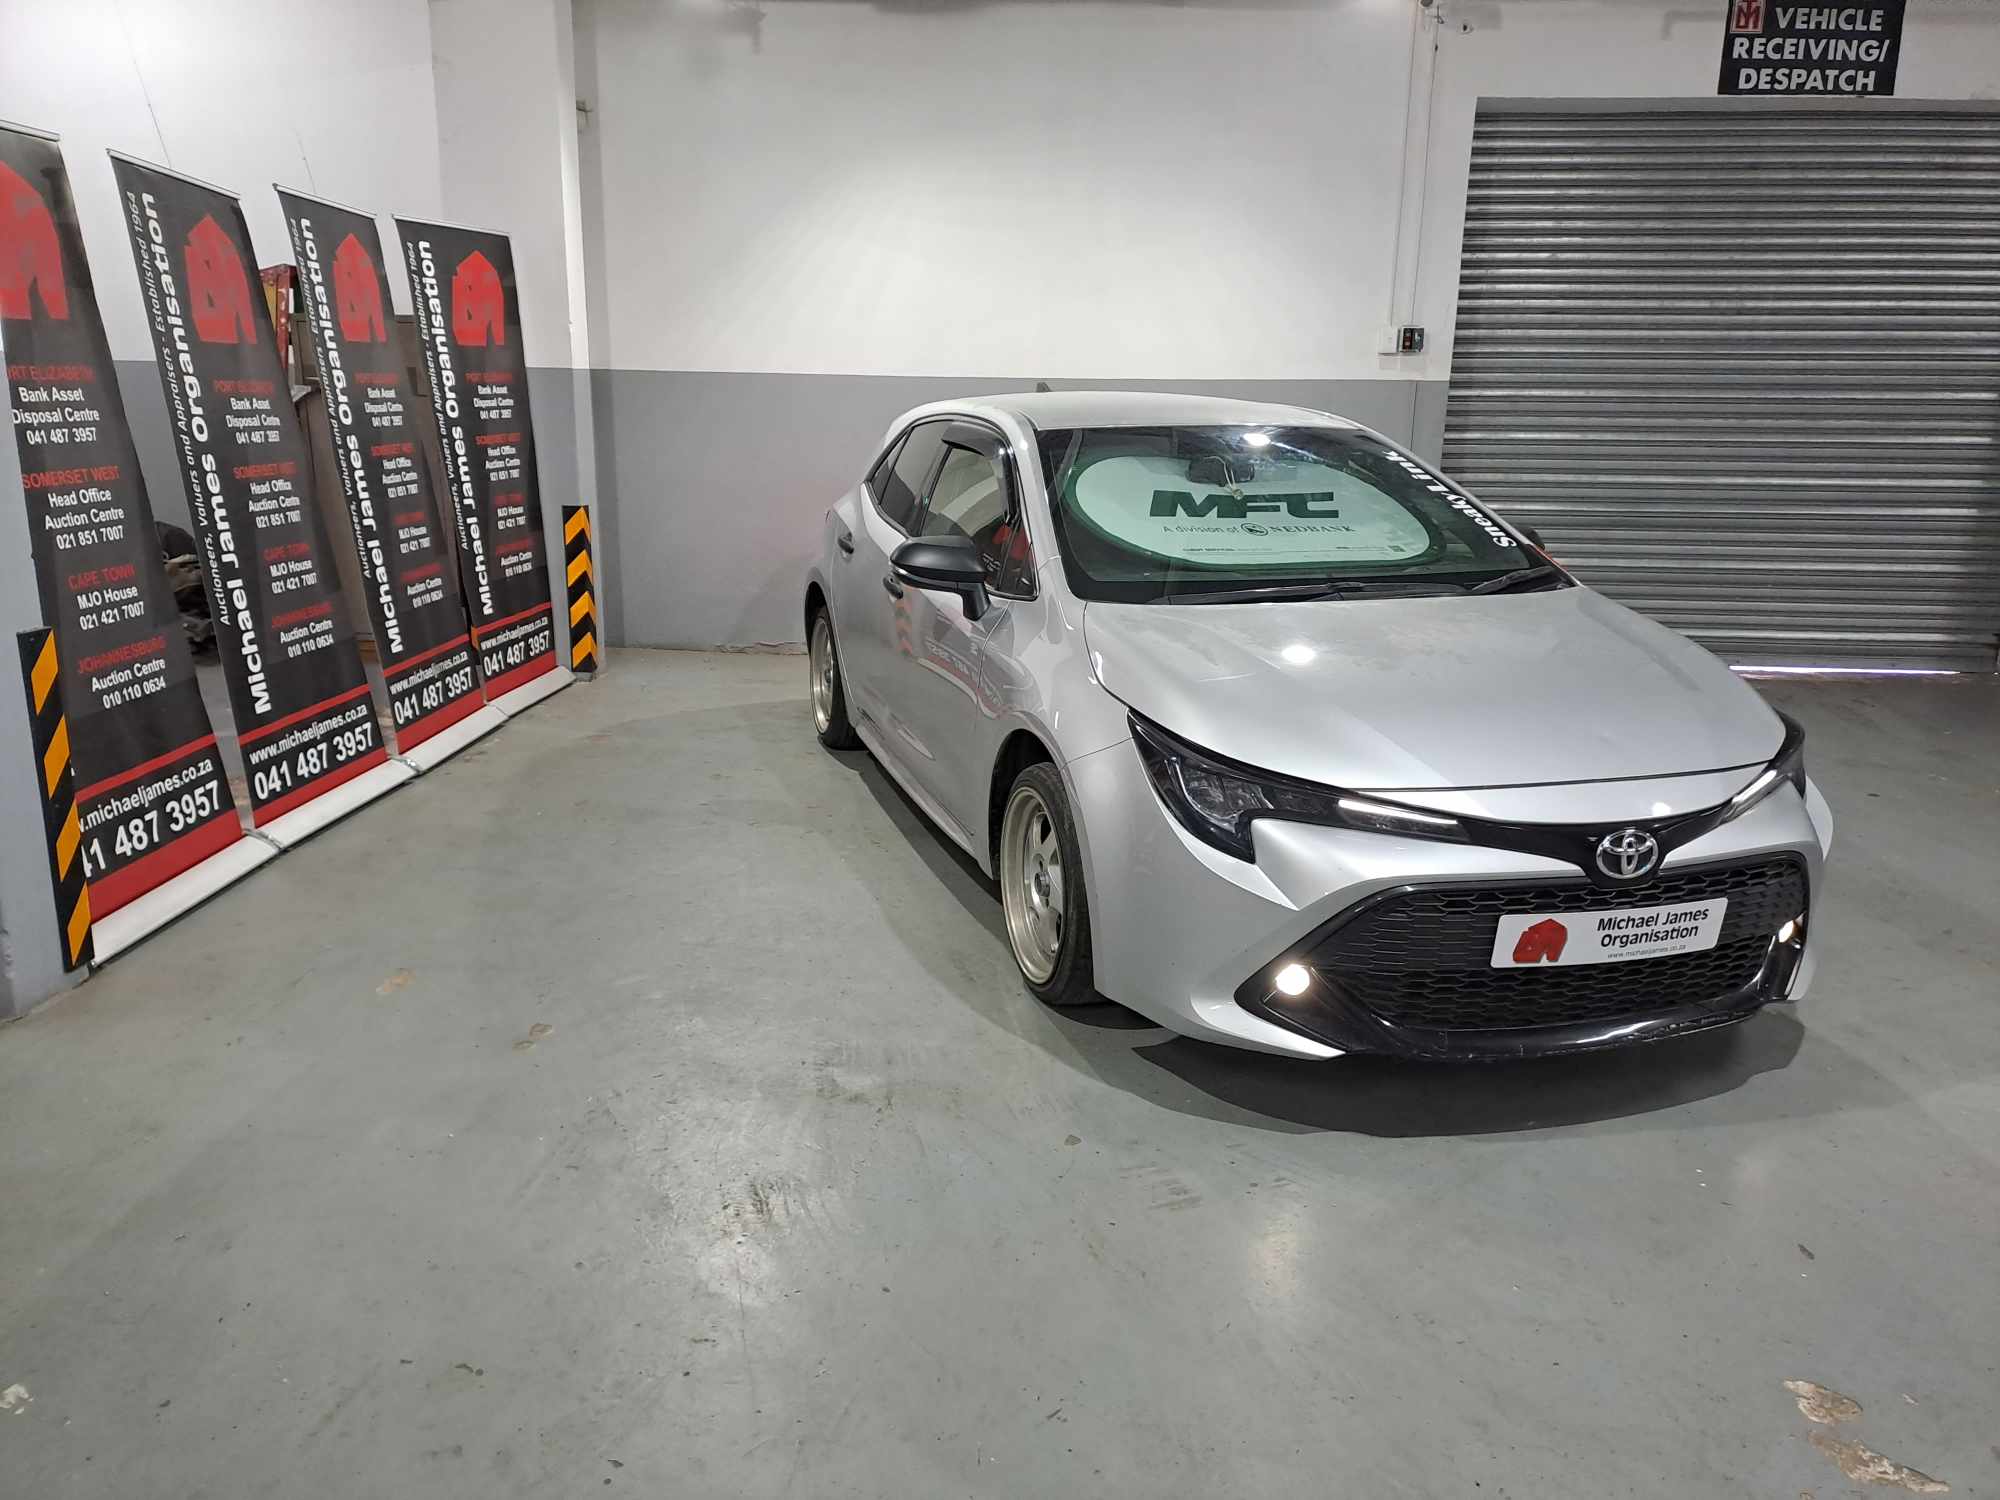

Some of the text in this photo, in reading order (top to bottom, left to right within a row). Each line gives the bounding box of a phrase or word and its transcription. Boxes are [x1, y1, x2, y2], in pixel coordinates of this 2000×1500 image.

[1775, 7, 1884, 32] VEHICLE
[1732, 37, 1890, 63] RECEIVING/
[1738, 67, 1876, 92] DESPATCH
[126, 191, 143, 232] 1964
[137, 238, 165, 331] Established
[300, 218, 352, 426] Organisation
[18, 386, 85, 402] Bank Asset
[162, 346, 188, 435] Appraisers
[230, 397, 251, 410] Bank
[12, 407, 100, 427] Disposal Centre
[226, 414, 260, 429] Disposal
[418, 240, 494, 616] Michael James Organisation
[26, 427, 97, 446] 041 487 3957
[236, 433, 250, 444] 041
[142, 192, 272, 715] Michael James Organisation
[182, 434, 196, 467] and
[22, 465, 120, 489] SOMERSET WEST
[250, 481, 270, 495] Head
[346, 435, 376, 531] James
[47, 487, 112, 509] Head Office
[190, 472, 209, 526] Valuers
[249, 498, 278, 512] Auction
[1150, 490, 1339, 518] MFC
[1382, 450, 1517, 548] Sneaky Link
[44, 506, 125, 531] Auction Centre
[255, 515, 270, 529] 021
[1175, 525, 1224, 533] division
[1269, 525, 1356, 533] NEDBANK
[56, 525, 124, 550] 021 851 7007
[68, 564, 135, 590] CAPE TOWN
[288, 559, 313, 573] House
[77, 585, 138, 610] MJO House
[272, 582, 285, 594] 021
[286, 577, 300, 590] 421
[366, 539, 403, 654] Michael
[80, 601, 144, 631] 021 421 7007
[280, 627, 309, 643] Auction
[483, 630, 549, 676] 041 487 3957
[91, 658, 166, 692] Auction Centre
[103, 677, 166, 709] 010 110 0634
[394, 666, 473, 725] 041 487 3957
[254, 721, 373, 800] 041 487 3957
[115, 810, 160, 857] 487
[166, 780, 220, 831] 3957
[1597, 908, 1709, 931] Michael James
[1600, 926, 1699, 948] Organisation
